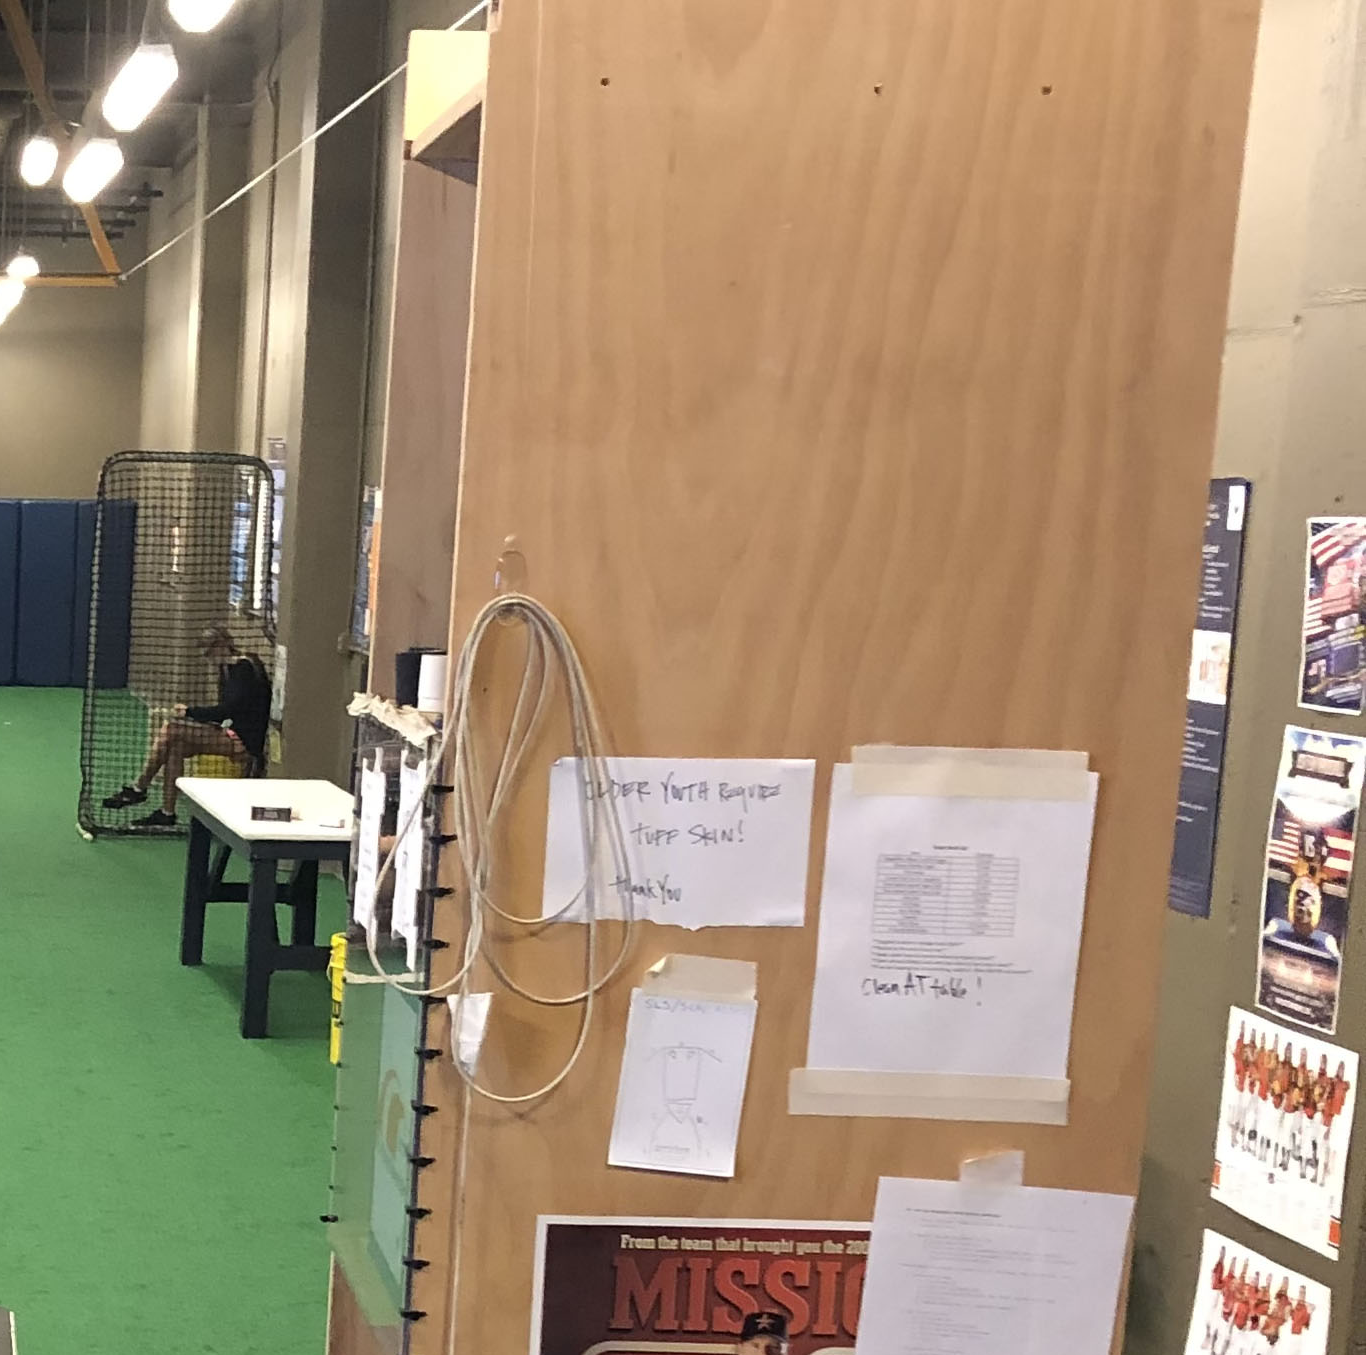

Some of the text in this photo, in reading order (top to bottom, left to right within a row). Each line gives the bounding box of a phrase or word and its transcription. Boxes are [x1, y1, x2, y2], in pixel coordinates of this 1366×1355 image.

[620, 1234, 656, 1249] From
[657, 1235, 679, 1250] the
[680, 1237, 713, 1251] team
[715, 1237, 741, 1251] that
[742, 1237, 794, 1255] brought
[795, 1242, 822, 1255] you
[822, 1239, 845, 1254] the
